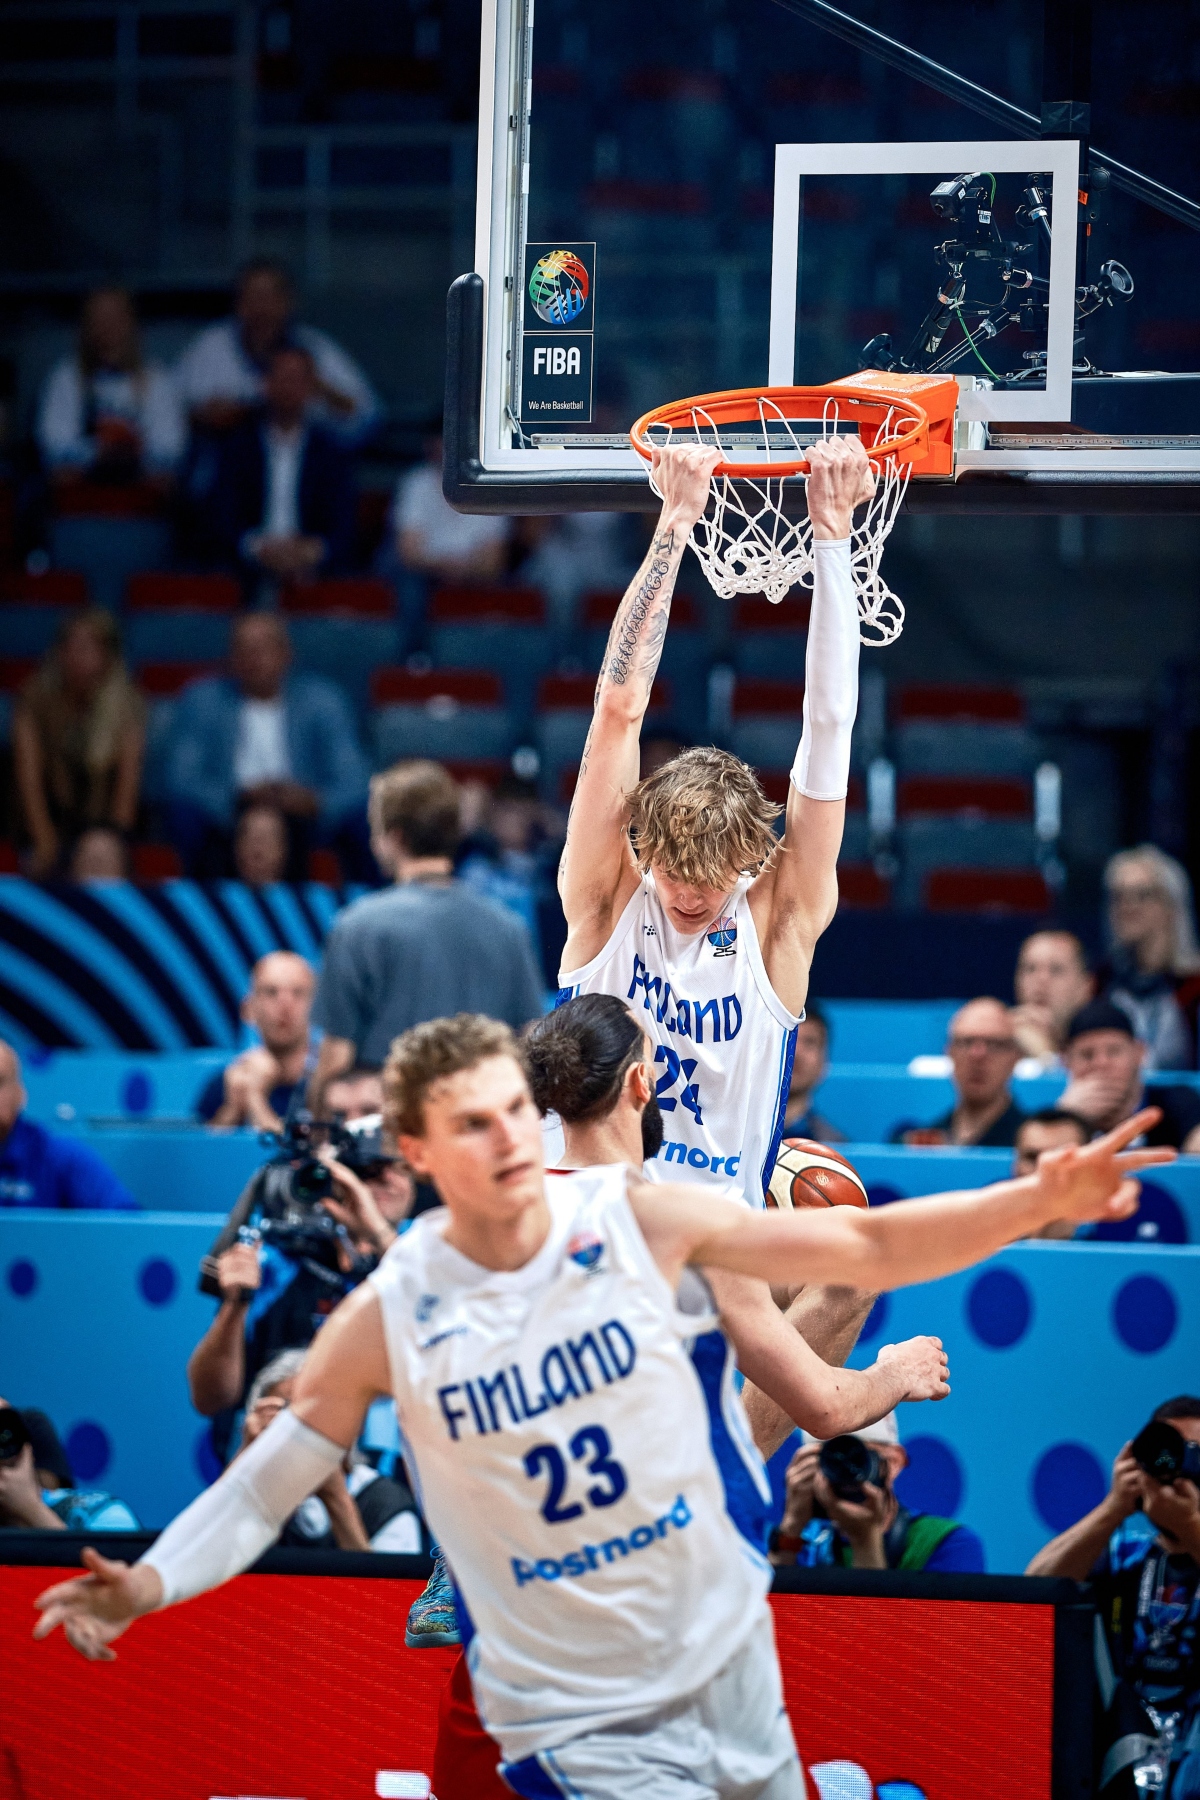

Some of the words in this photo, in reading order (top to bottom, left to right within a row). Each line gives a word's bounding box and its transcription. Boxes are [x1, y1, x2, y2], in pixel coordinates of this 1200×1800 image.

[533, 347, 580, 375] FIBA
[528, 401, 540, 410] We
[540, 401, 552, 410] Are
[552, 400, 584, 410] Basketball
[713, 946, 737, 957] 25
[654, 1045, 704, 1125] 24
[522, 1425, 628, 1526] 23
[510, 1494, 693, 1587] postnord
